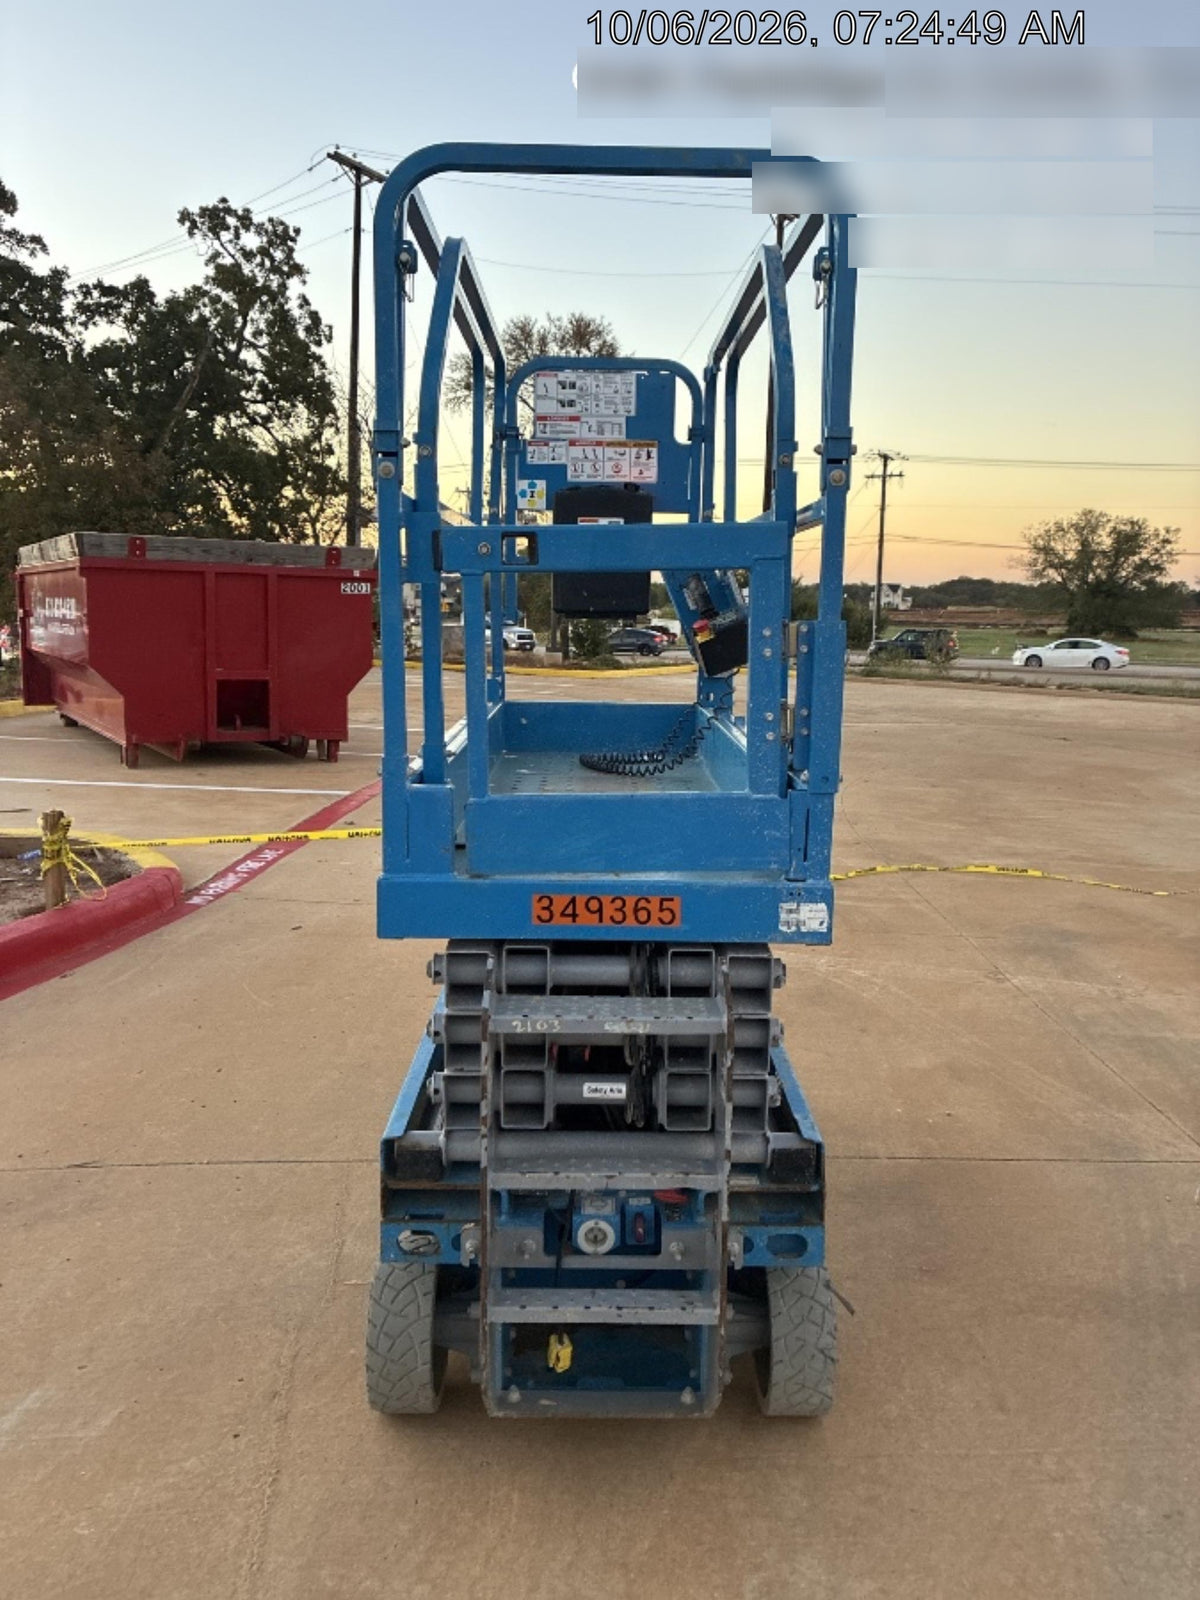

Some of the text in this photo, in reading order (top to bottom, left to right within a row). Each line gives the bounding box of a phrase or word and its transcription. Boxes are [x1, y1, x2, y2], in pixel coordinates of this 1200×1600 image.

[342, 583, 369, 593] 2001
[536, 895, 676, 925] 349365
[511, 1019, 561, 1032] 2103
